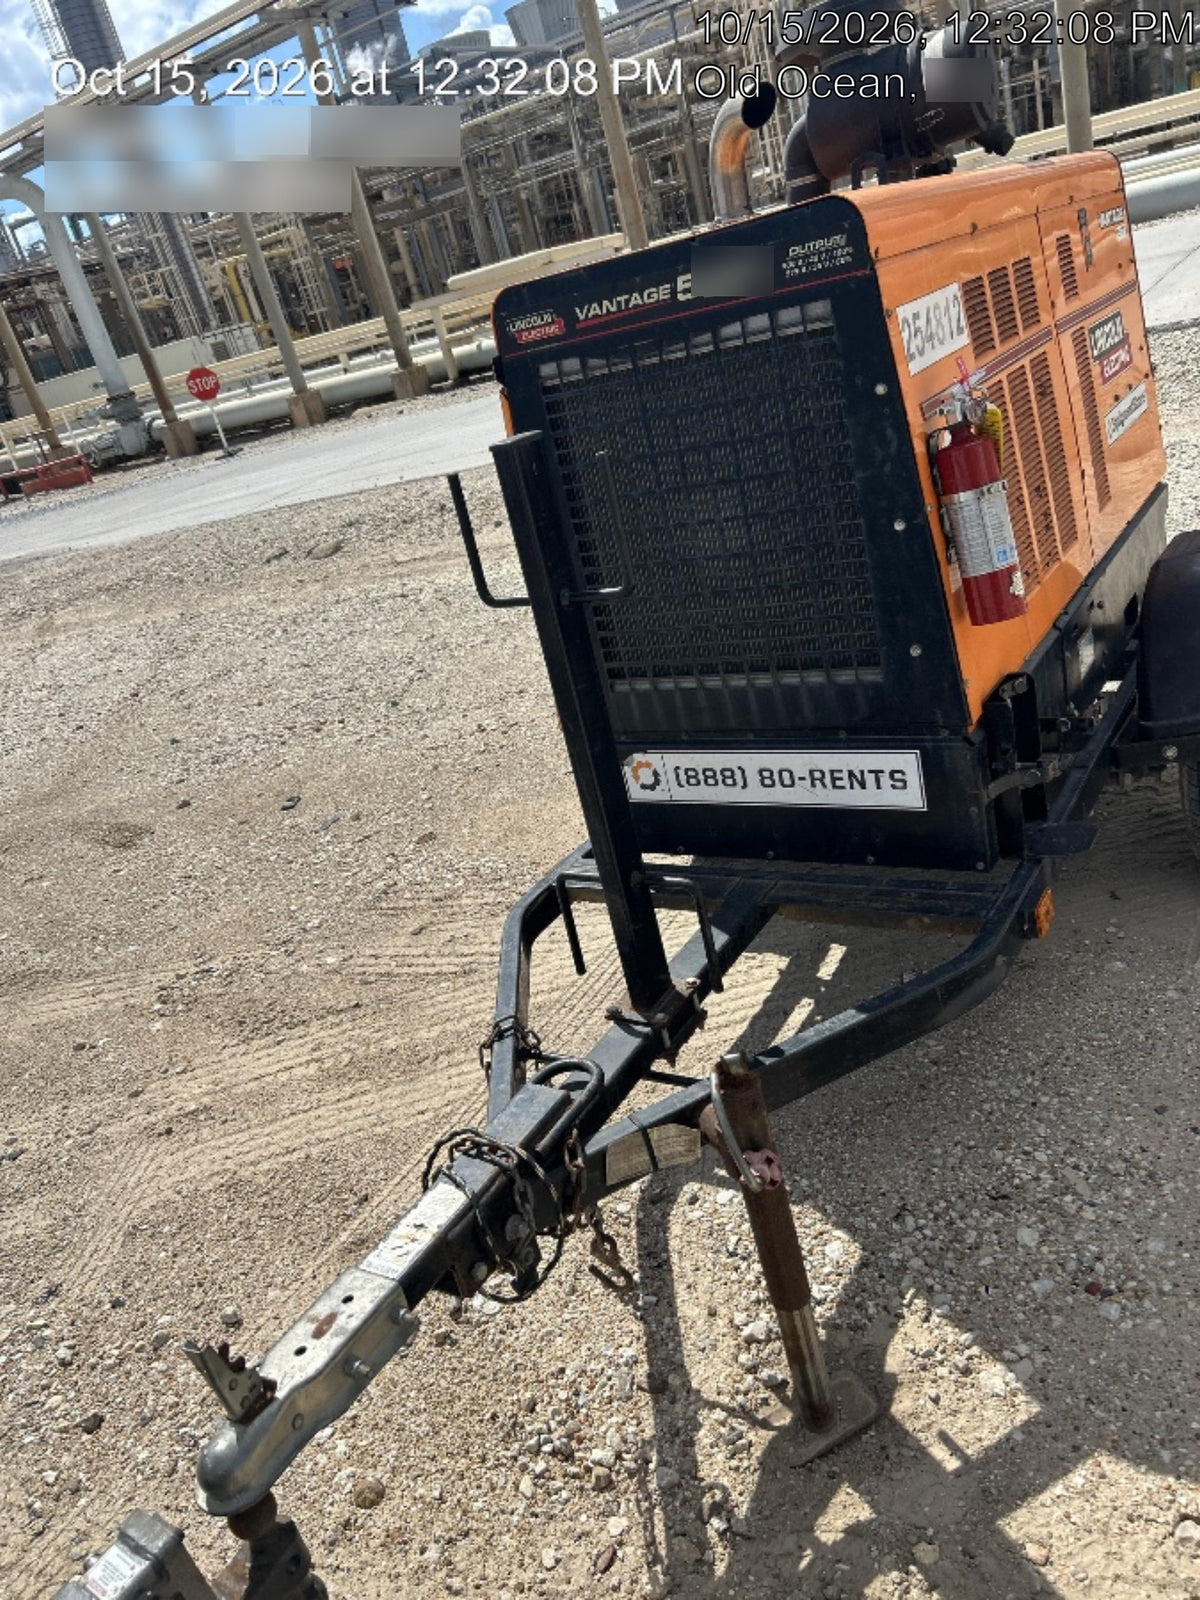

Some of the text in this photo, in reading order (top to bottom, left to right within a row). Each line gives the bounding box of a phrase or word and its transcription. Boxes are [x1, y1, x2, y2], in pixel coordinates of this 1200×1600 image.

[575, 284, 671, 320] VANTAGE
[901, 293, 965, 362] 254812
[188, 376, 217, 394] STOP
[673, 765, 909, 791] (888) 80-RENTS
